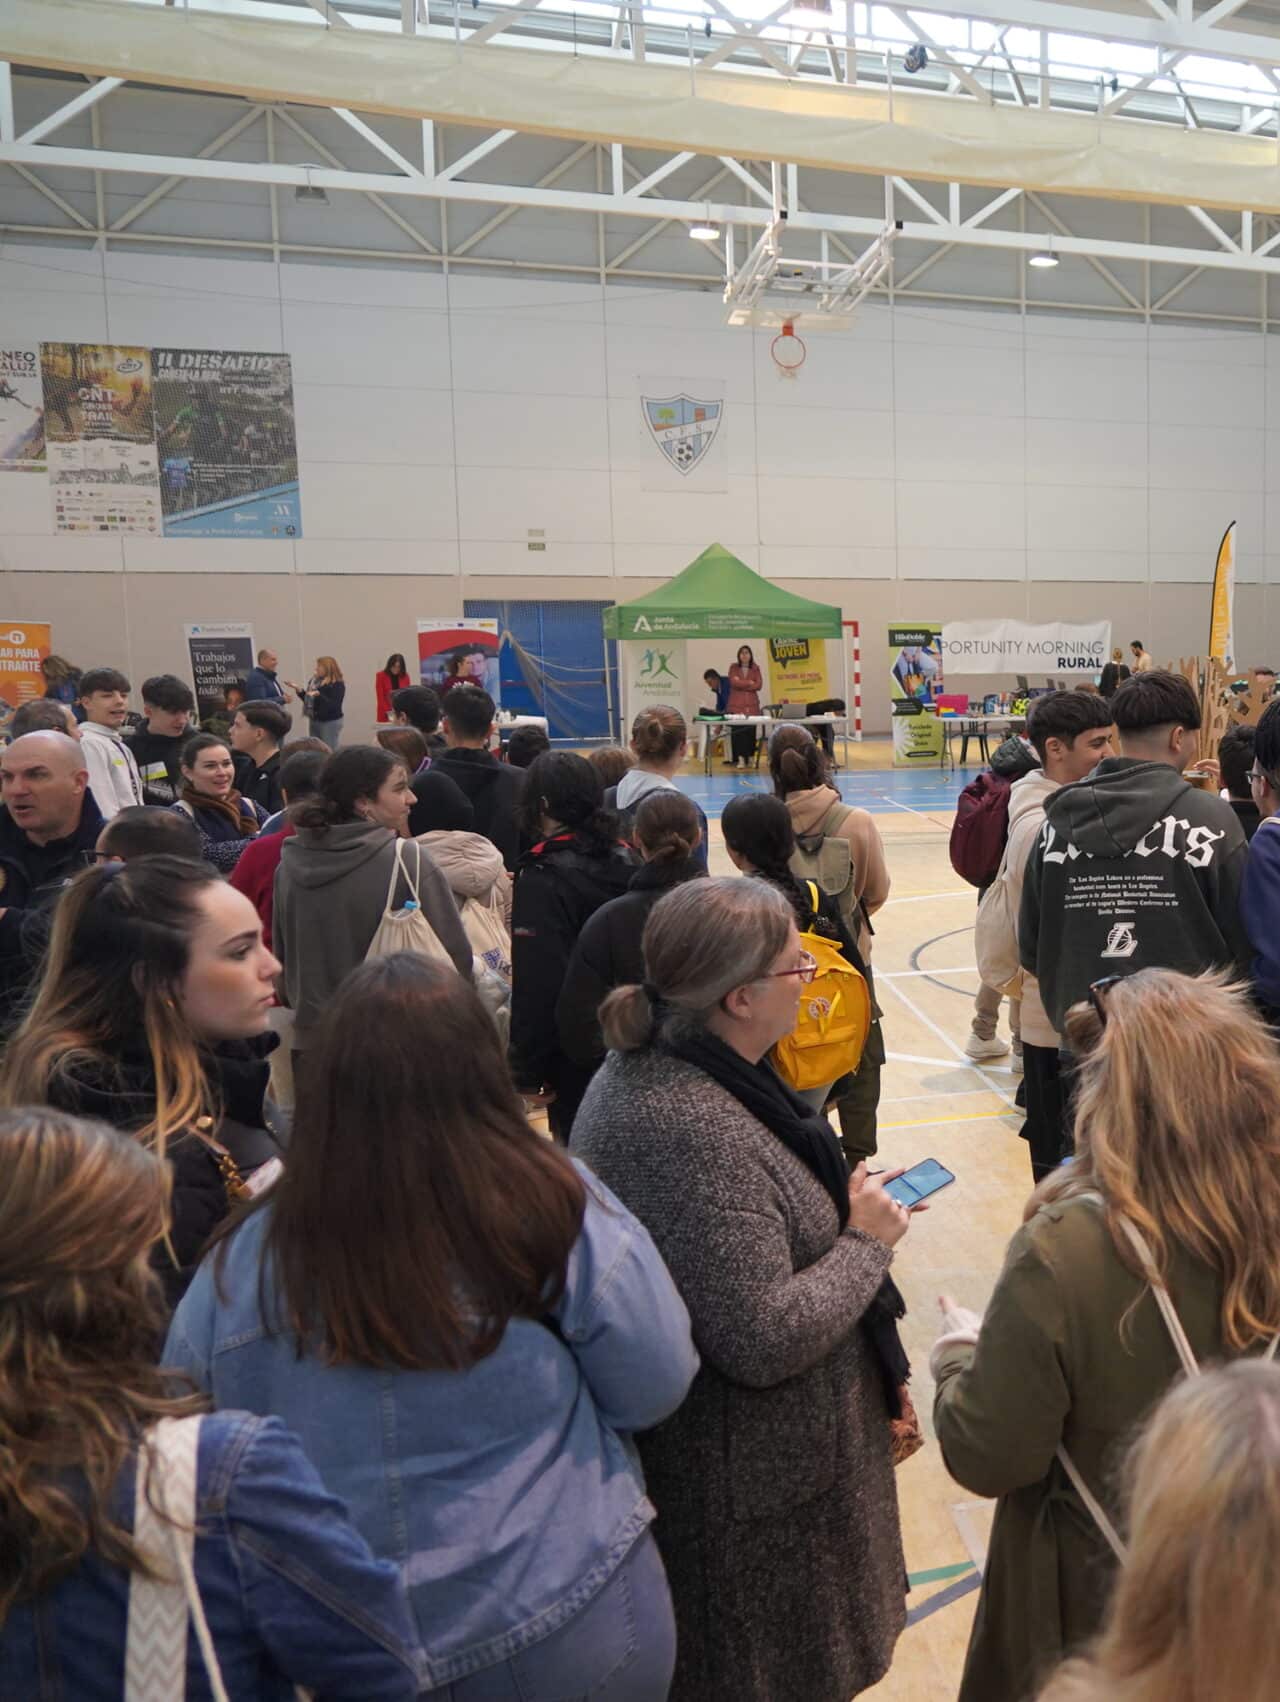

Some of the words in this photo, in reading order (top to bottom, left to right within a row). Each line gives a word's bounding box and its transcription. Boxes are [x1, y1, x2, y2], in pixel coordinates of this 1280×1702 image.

[79, 385, 112, 401] CNT
[16, 648, 40, 658] PARA
[776, 645, 806, 658] JOVEN
[1026, 641, 1104, 655] MORNING
[193, 650, 236, 664] Trabajos
[1057, 657, 1102, 668] RURAL
[195, 665, 215, 675] que
[216, 662, 226, 673] lo
[196, 674, 238, 685] cambian
[198, 685, 218, 696] todo
